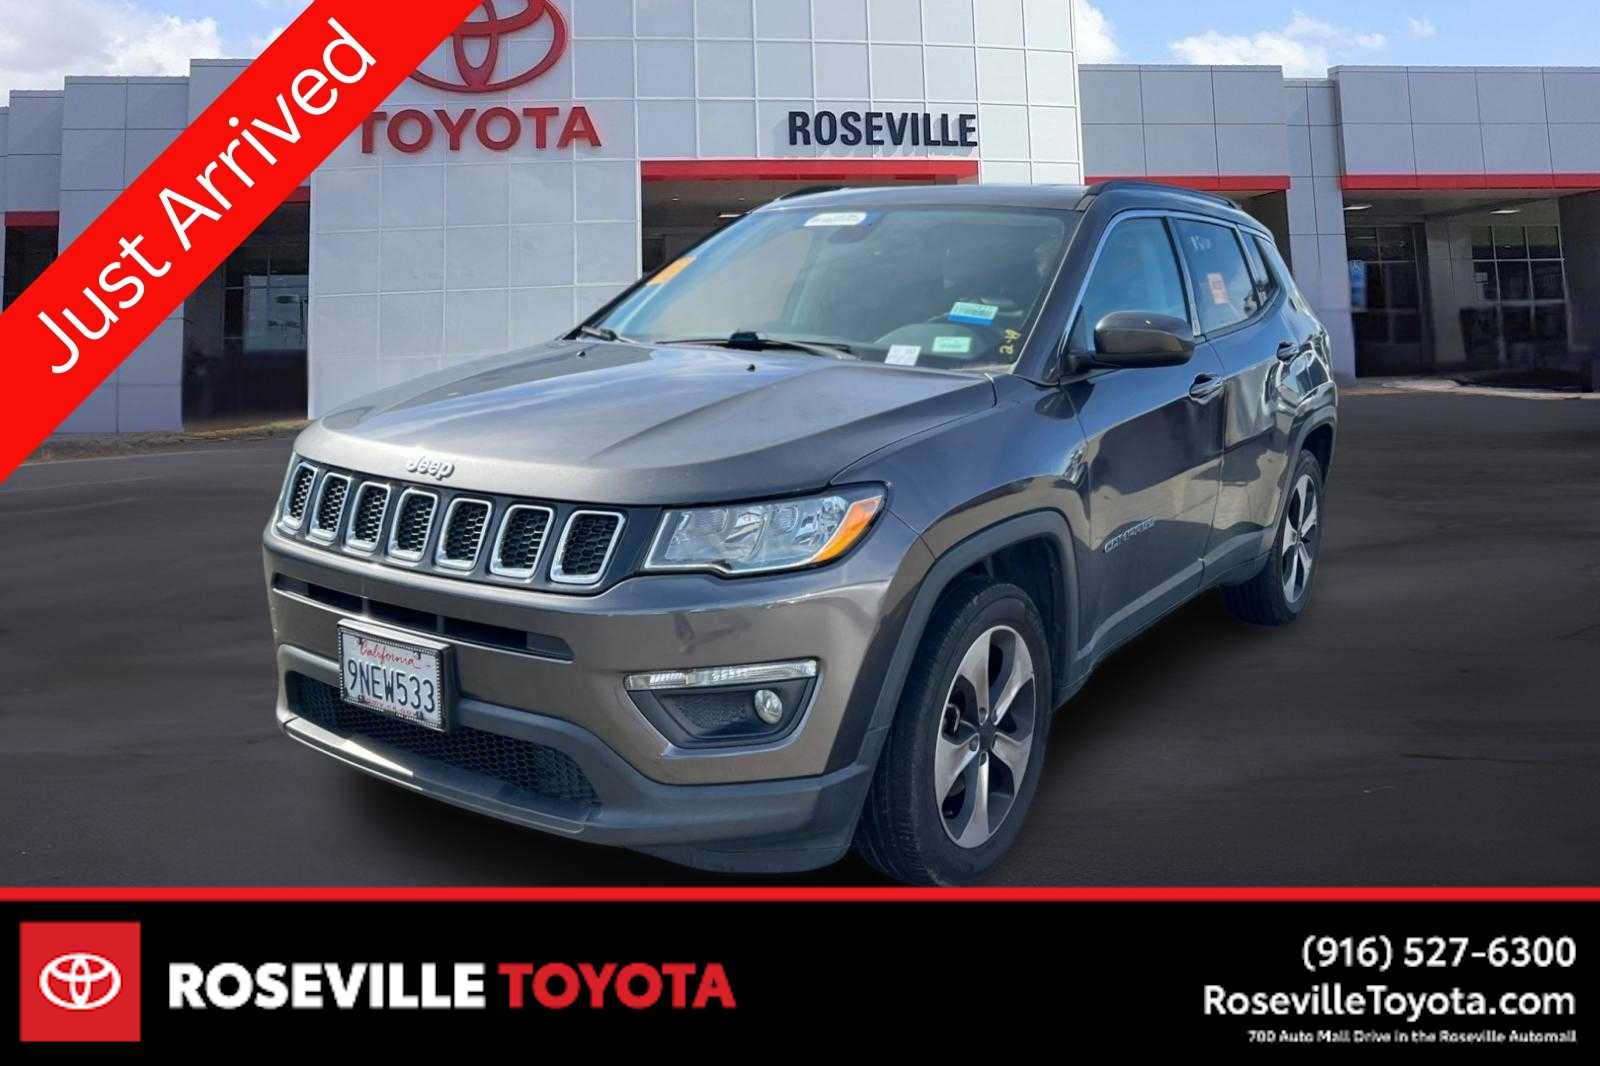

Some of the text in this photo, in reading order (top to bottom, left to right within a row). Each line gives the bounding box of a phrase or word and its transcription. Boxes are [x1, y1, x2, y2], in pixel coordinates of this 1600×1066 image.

[361, 107, 602, 153] TOYOTA
[788, 111, 978, 147] ROSEVILLE
[406, 454, 455, 481] Jeep
[347, 659, 436, 714] 9NEW533
